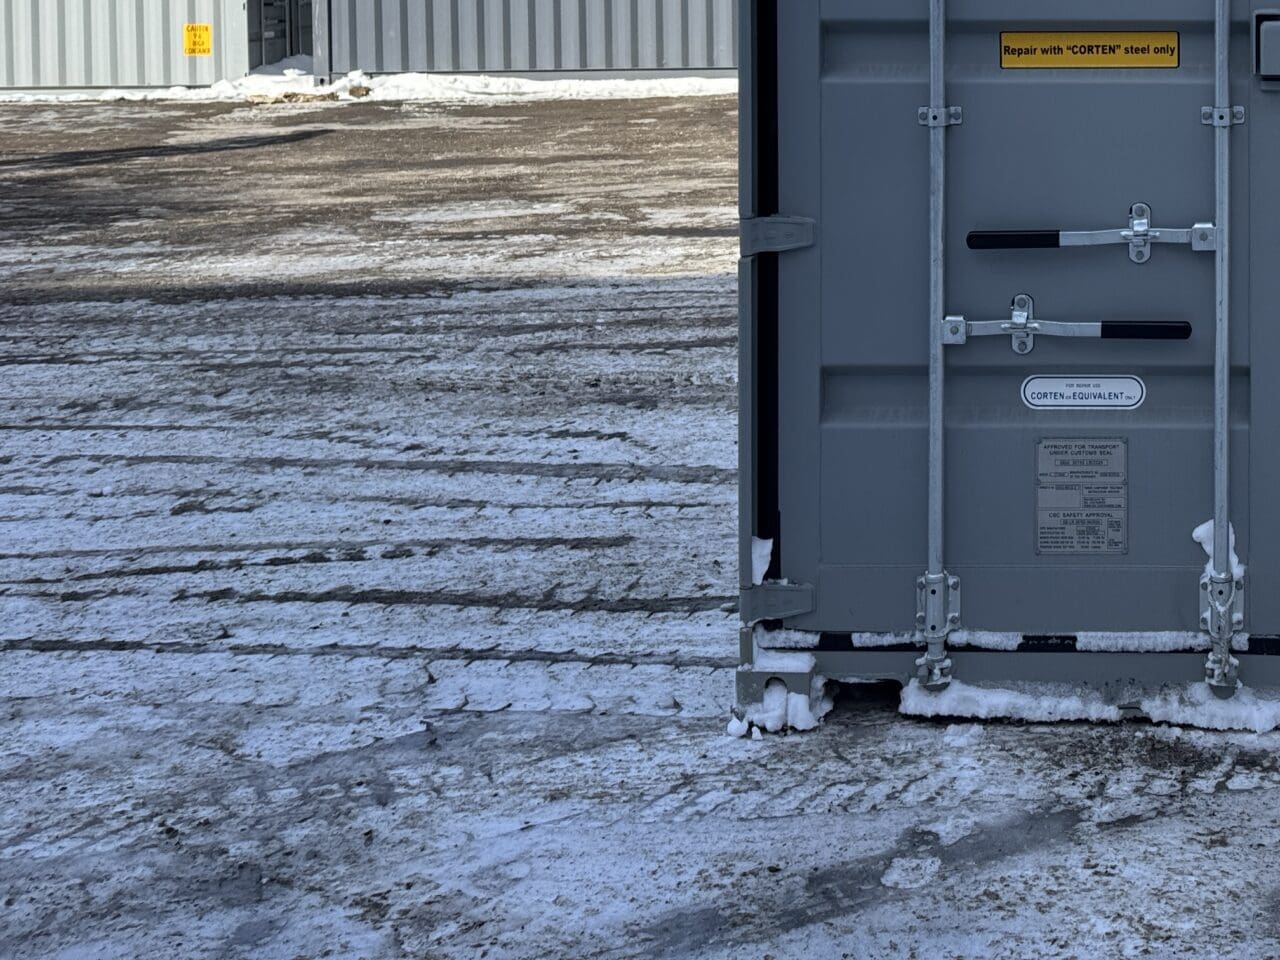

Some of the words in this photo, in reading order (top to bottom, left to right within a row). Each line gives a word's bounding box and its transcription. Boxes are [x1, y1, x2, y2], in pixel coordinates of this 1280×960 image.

[1003, 45, 1037, 57] Repair
[1040, 45, 1063, 55] with
[1124, 45, 1150, 54] steel
[1153, 45, 1175, 56] only
[1030, 392, 1064, 400] CORTEN
[1072, 392, 1125, 400] EQUIVALENT
